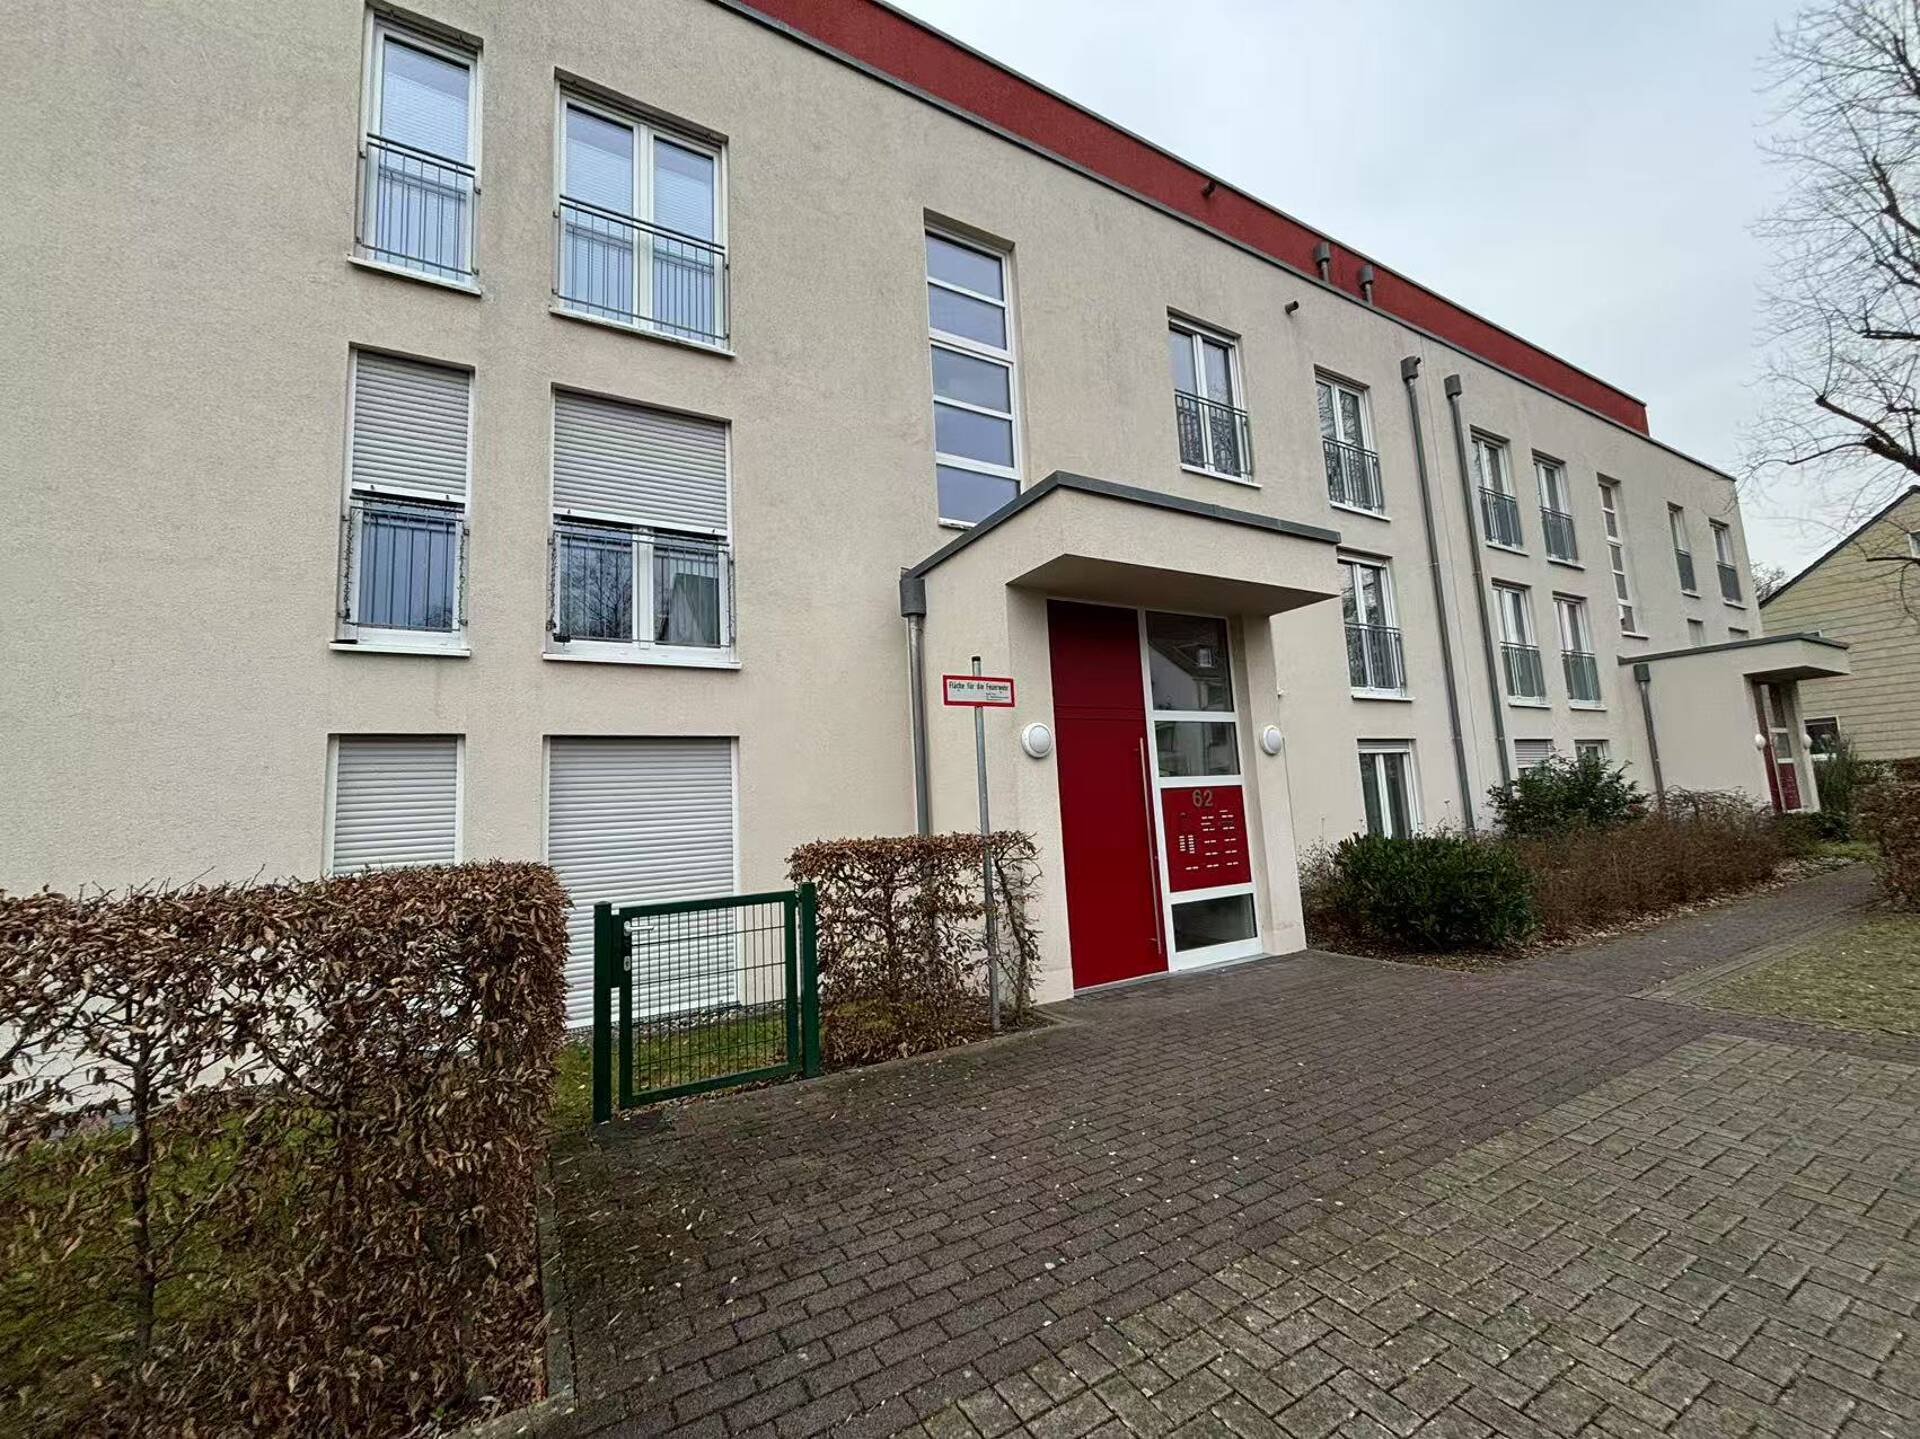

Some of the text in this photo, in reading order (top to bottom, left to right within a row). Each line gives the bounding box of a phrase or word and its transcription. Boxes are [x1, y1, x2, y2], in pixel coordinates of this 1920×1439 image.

[949, 681, 1009, 691] Fläche für die Feuerwehr
[1192, 789, 1213, 807] 62
